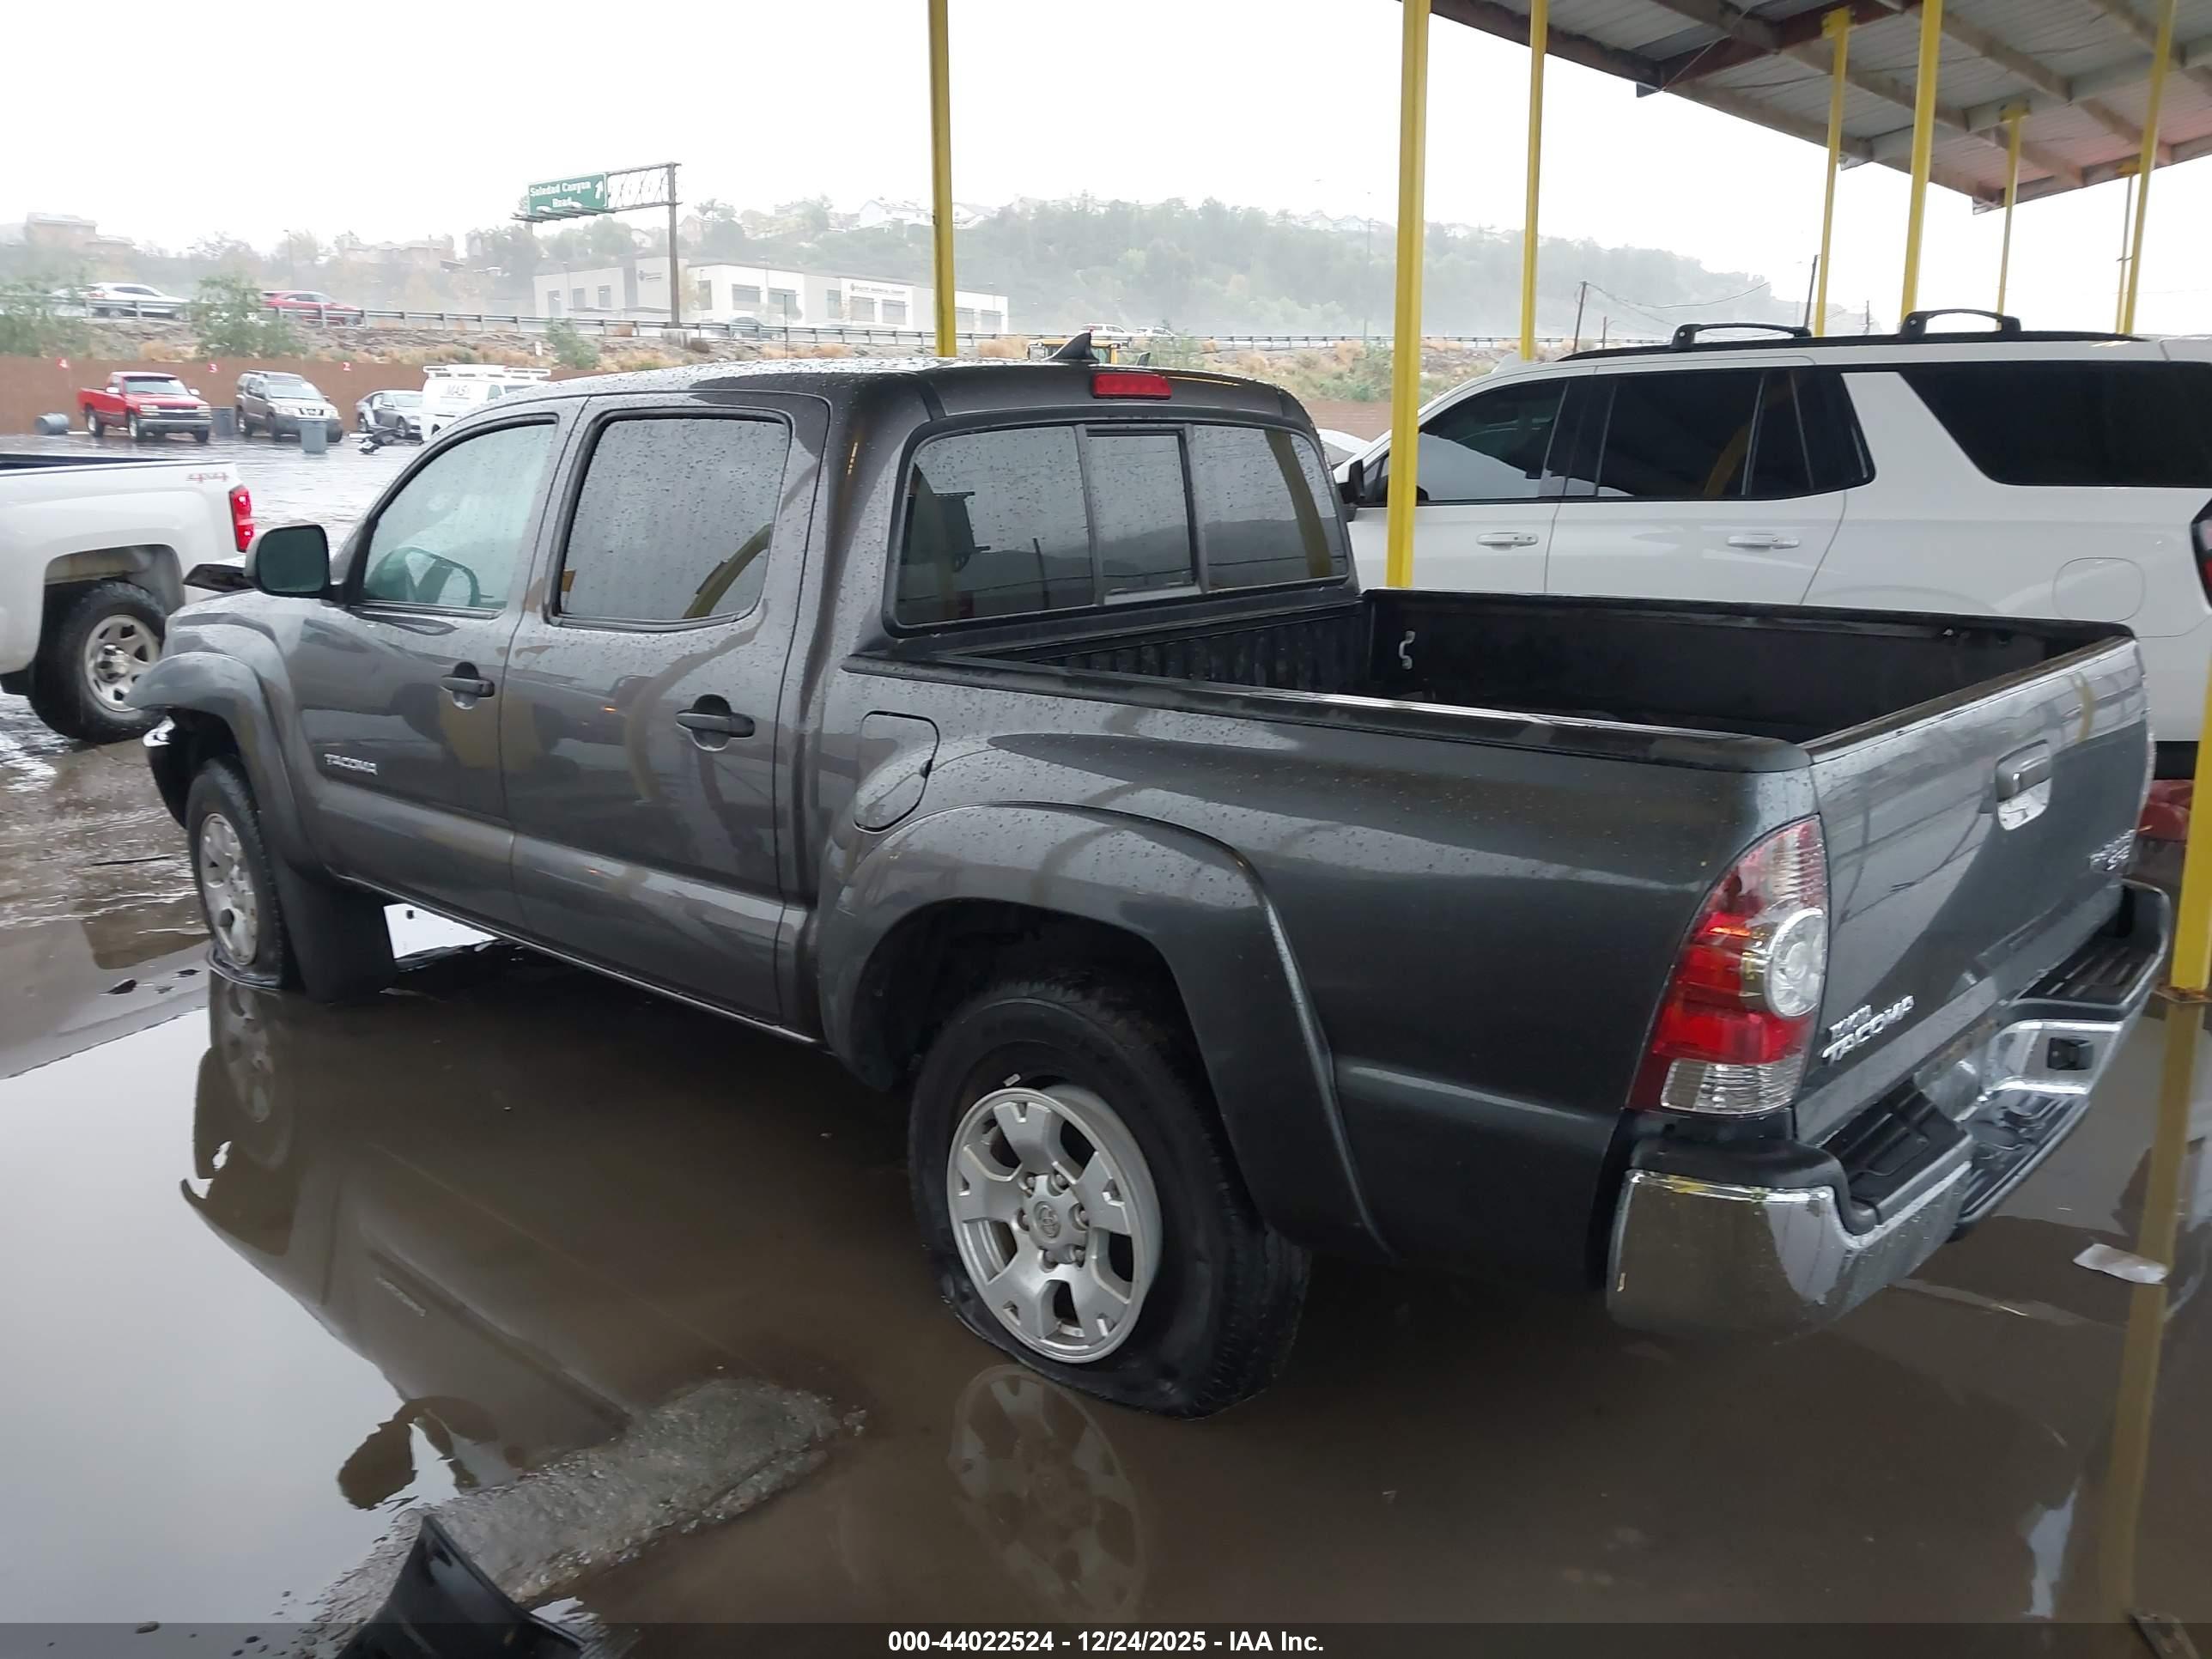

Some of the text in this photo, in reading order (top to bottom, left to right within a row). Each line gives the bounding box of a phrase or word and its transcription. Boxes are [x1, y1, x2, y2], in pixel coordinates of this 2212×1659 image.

[209, 363, 218, 373] 3
[343, 362, 351, 371] 2
[323, 752, 379, 776] TACOMA
[1821, 995, 1915, 1063] TACOMA
